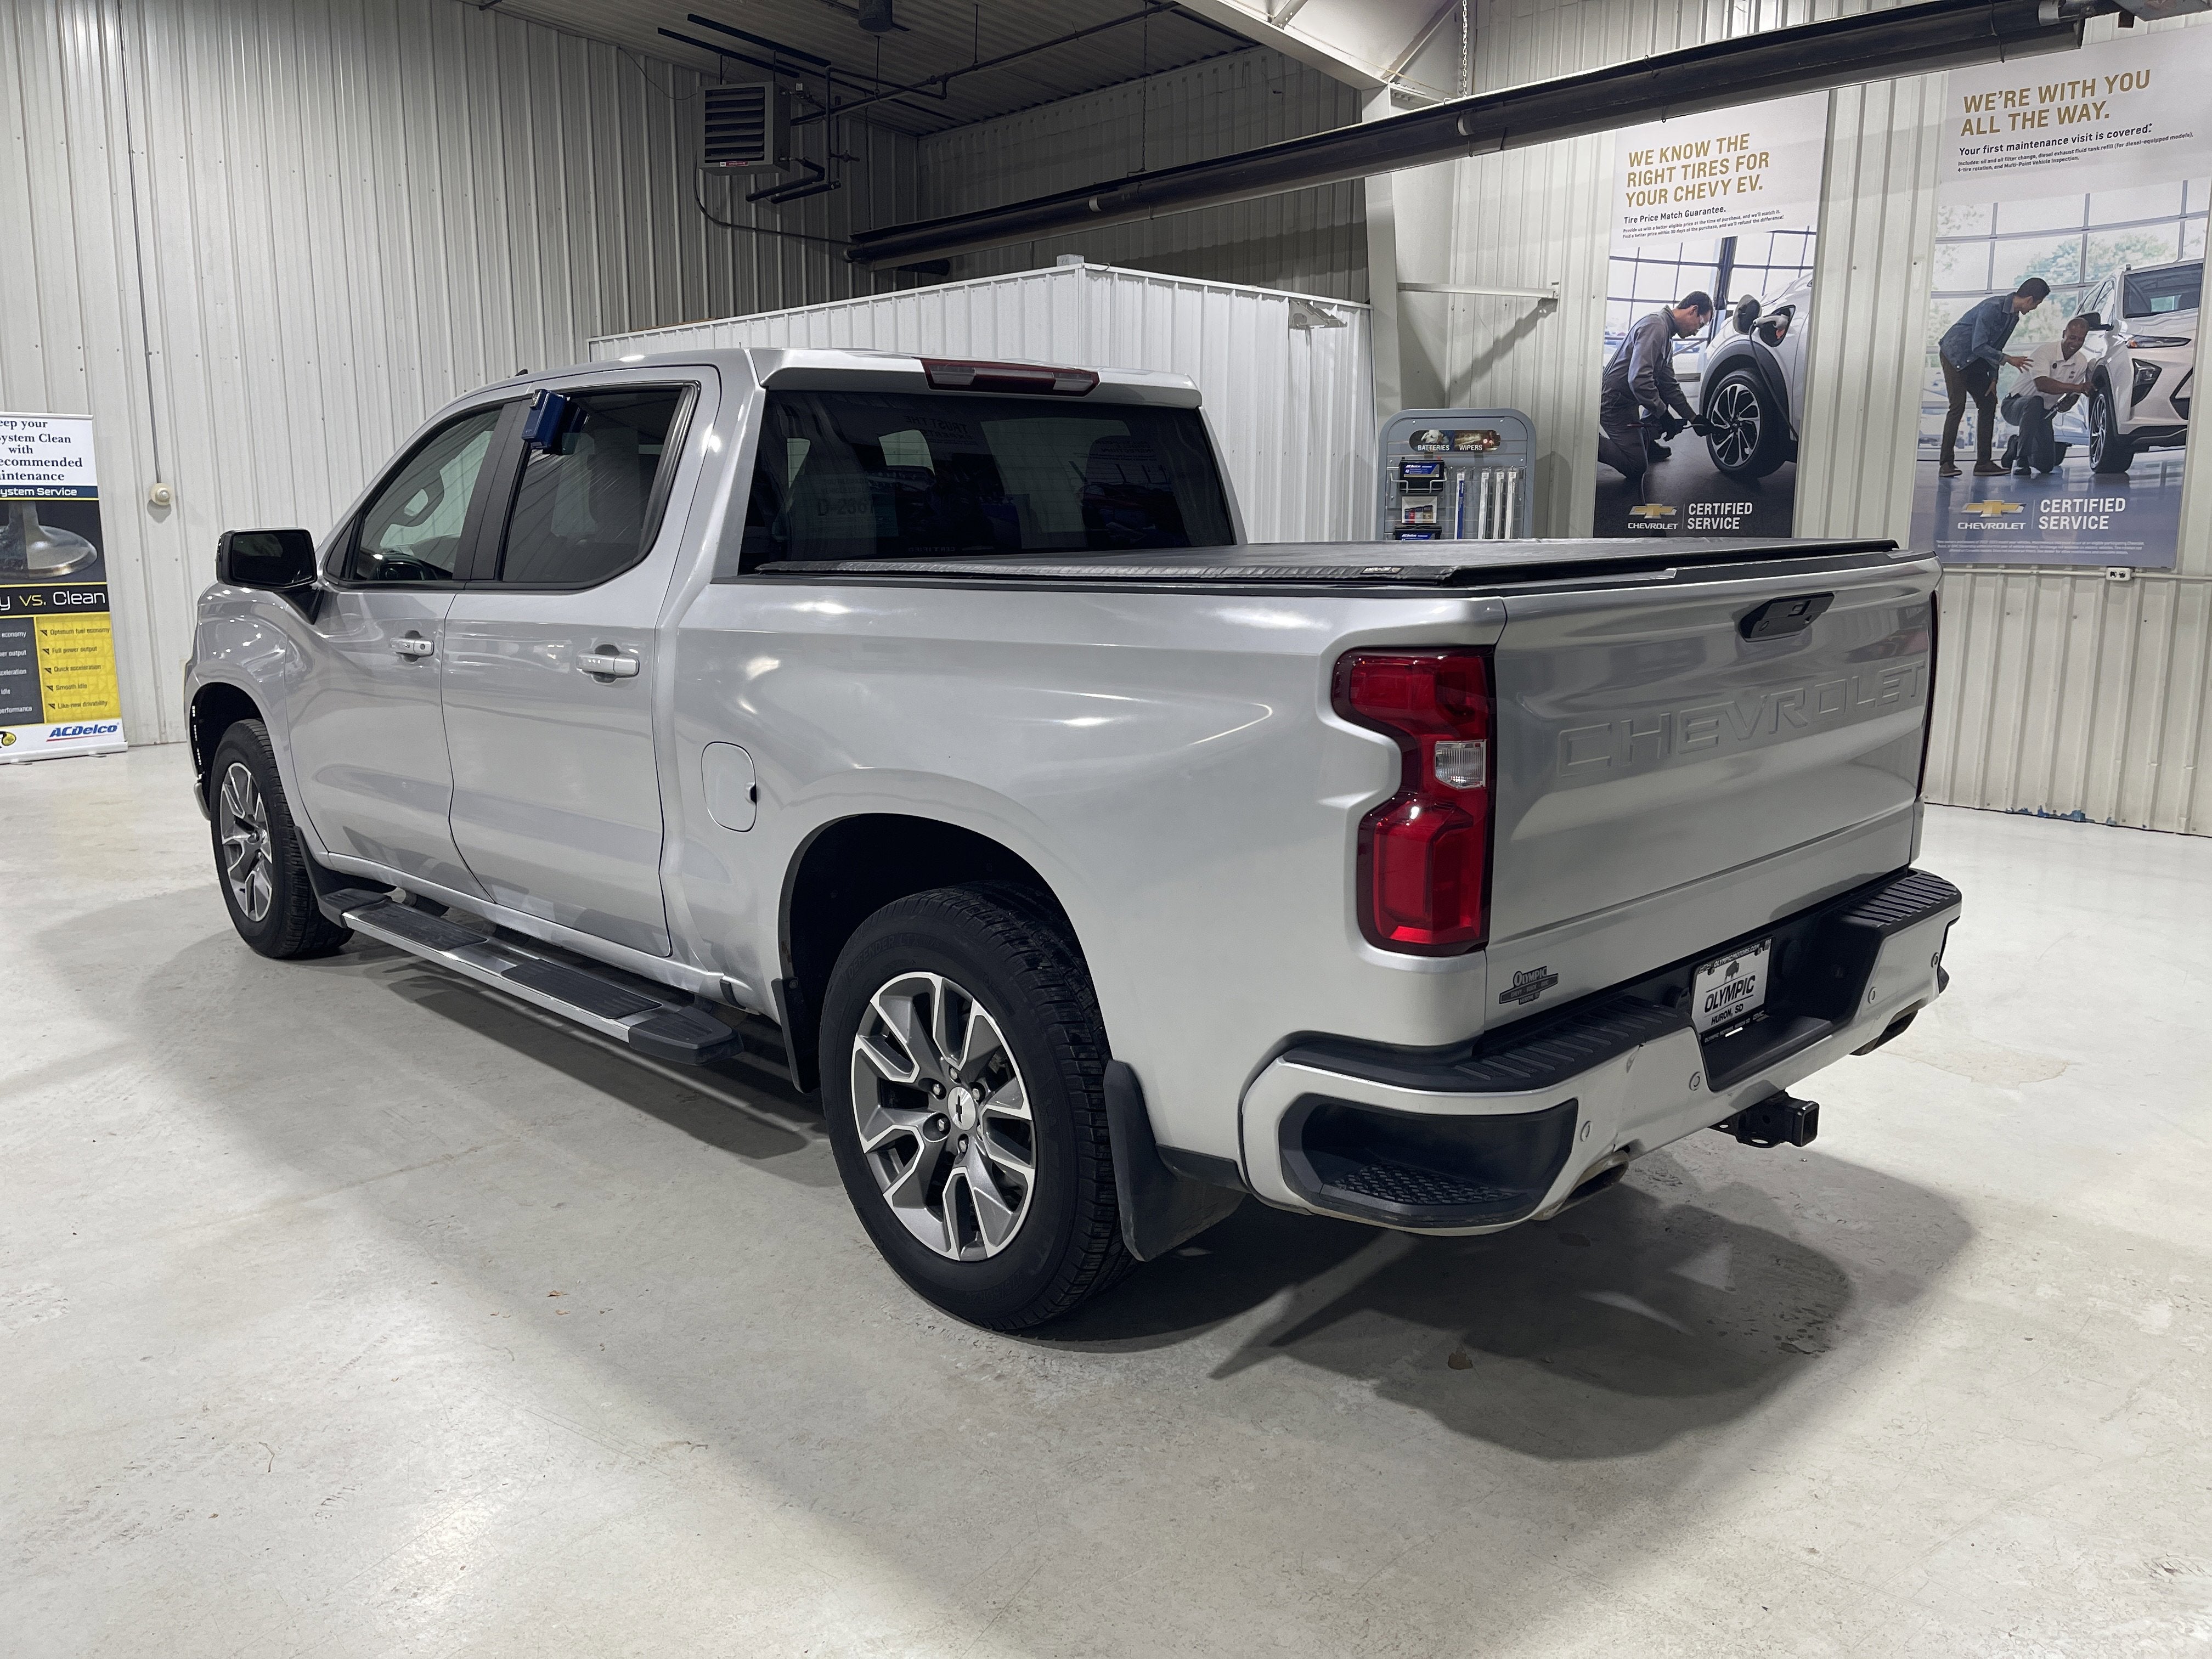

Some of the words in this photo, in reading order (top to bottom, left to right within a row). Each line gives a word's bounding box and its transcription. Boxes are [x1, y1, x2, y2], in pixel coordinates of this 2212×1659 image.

[1963, 87, 2031, 113] WE'RE
[2038, 78, 2096, 104] WITH
[2104, 69, 2151, 94] YOU
[1961, 116, 2000, 136] ALL
[2008, 109, 2049, 131] THE
[2057, 100, 2109, 125] WAY.
[1960, 147, 1980, 155] Your
[1983, 144, 2003, 154] first
[2006, 138, 2068, 151] maintenance
[2072, 133, 2093, 144] visit
[2095, 132, 2104, 140] is
[2125, 136, 2169, 147] diesel-equipped
[1629, 149, 1654, 167] WE
[1660, 140, 1711, 163] KNOW
[1717, 133, 1750, 154] THE
[1627, 166, 1675, 188] RIGHT
[1681, 159, 1729, 181] TIRES
[1735, 151, 1769, 172] FOR
[1626, 188, 1668, 207] YOUR
[1674, 178, 1732, 202] CHEVY
[1737, 174, 1763, 193] EV.
[1661, 211, 1682, 220] Match
[1685, 207, 1726, 217] Guarantee.
[0, 420, 17, 430] eep
[21, 421, 48, 430] your
[0, 434, 35, 444] ystem
[39, 433, 71, 443] Clean
[8, 445, 33, 454] with
[0, 457, 83, 467] ecommended
[0, 470, 65, 481] intenance
[0, 487, 35, 498] ystem
[37, 487, 77, 496] Service
[1688, 502, 1753, 515] CERTIFIED
[2040, 498, 2126, 513] CERTIFIED
[1687, 517, 1740, 529] SERVICE
[1957, 522, 2026, 530] CHEVROLET
[2038, 515, 2109, 530] SERVICE
[19, 594, 46, 606] vs.
[53, 590, 105, 605] Clean
[1558, 661, 1926, 777] CHEVROLET
[49, 724, 117, 737] ACDelco
[1705, 975, 1756, 1013] OLYMPIC
[1711, 1008, 1733, 1025] HURON,
[1734, 1003, 1743, 1013] SD
